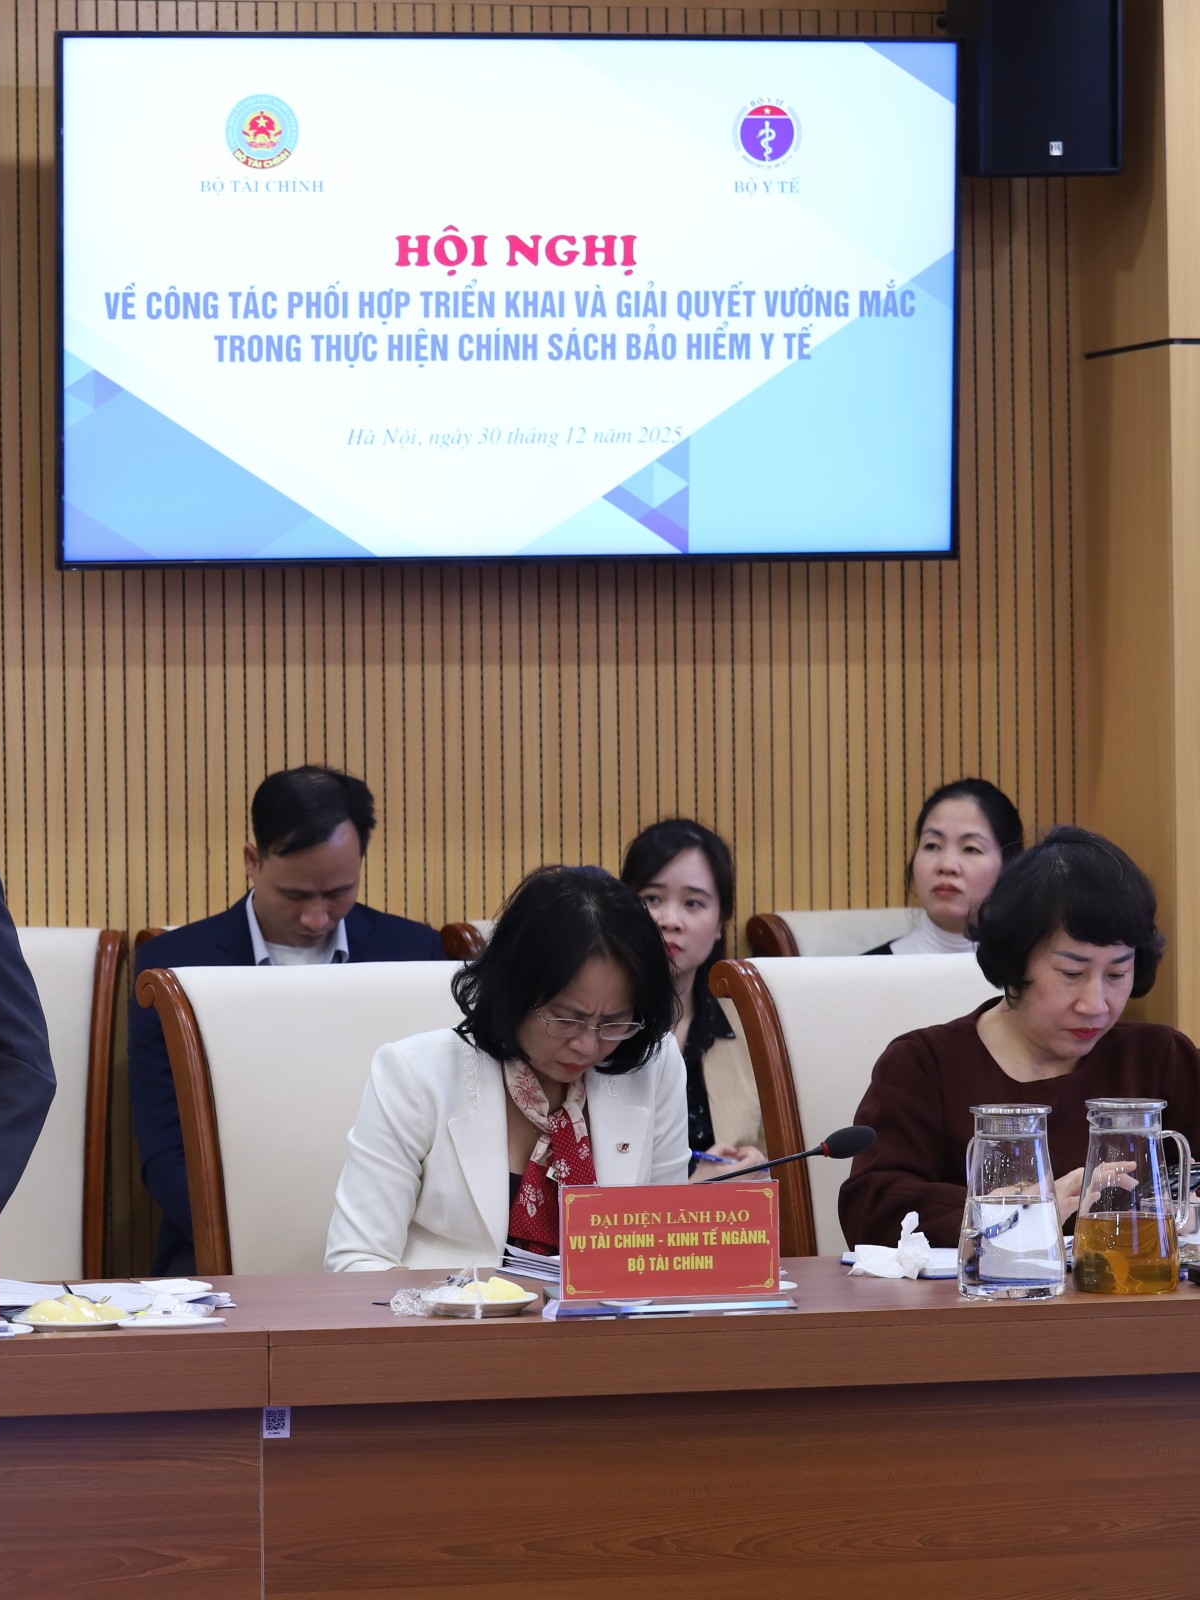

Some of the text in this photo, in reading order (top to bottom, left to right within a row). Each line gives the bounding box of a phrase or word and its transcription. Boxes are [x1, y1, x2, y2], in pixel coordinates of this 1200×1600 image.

[200, 176, 324, 197] BỘ TÀI CHÍNH
[734, 176, 800, 197] BỘ Y TẾ
[395, 224, 637, 276] HỘI NGHỊ
[104, 278, 916, 325] VỀ CÔNG TÁC PHỐI HỢP TRIỂN KHAI VÀ GIẢI QUYẾT VƯỚNG MẮC
[214, 321, 815, 368] TRONG THỰC HIỆN CHÍNH SÁCH BẢO HIỂM Y TẾ
[347, 428, 376, 446] Hà
[428, 428, 473, 450] ngày
[478, 427, 502, 445] 30
[507, 427, 559, 449] tháng
[566, 427, 587, 444] 12
[593, 428, 632, 444] năm
[637, 426, 683, 444] 2025
[590, 1208, 750, 1229] ĐẠI DIỆN LÃNH ĐẠO
[569, 1235, 587, 1252] VỤ
[590, 1232, 611, 1250] TÀI
[614, 1231, 655, 1249] CHÍNH
[667, 1231, 699, 1247] KINH
[702, 1227, 718, 1246] TẾ
[721, 1227, 771, 1246] NGÀNH,
[627, 1253, 714, 1275] BỘ TÀI CHÍNH
